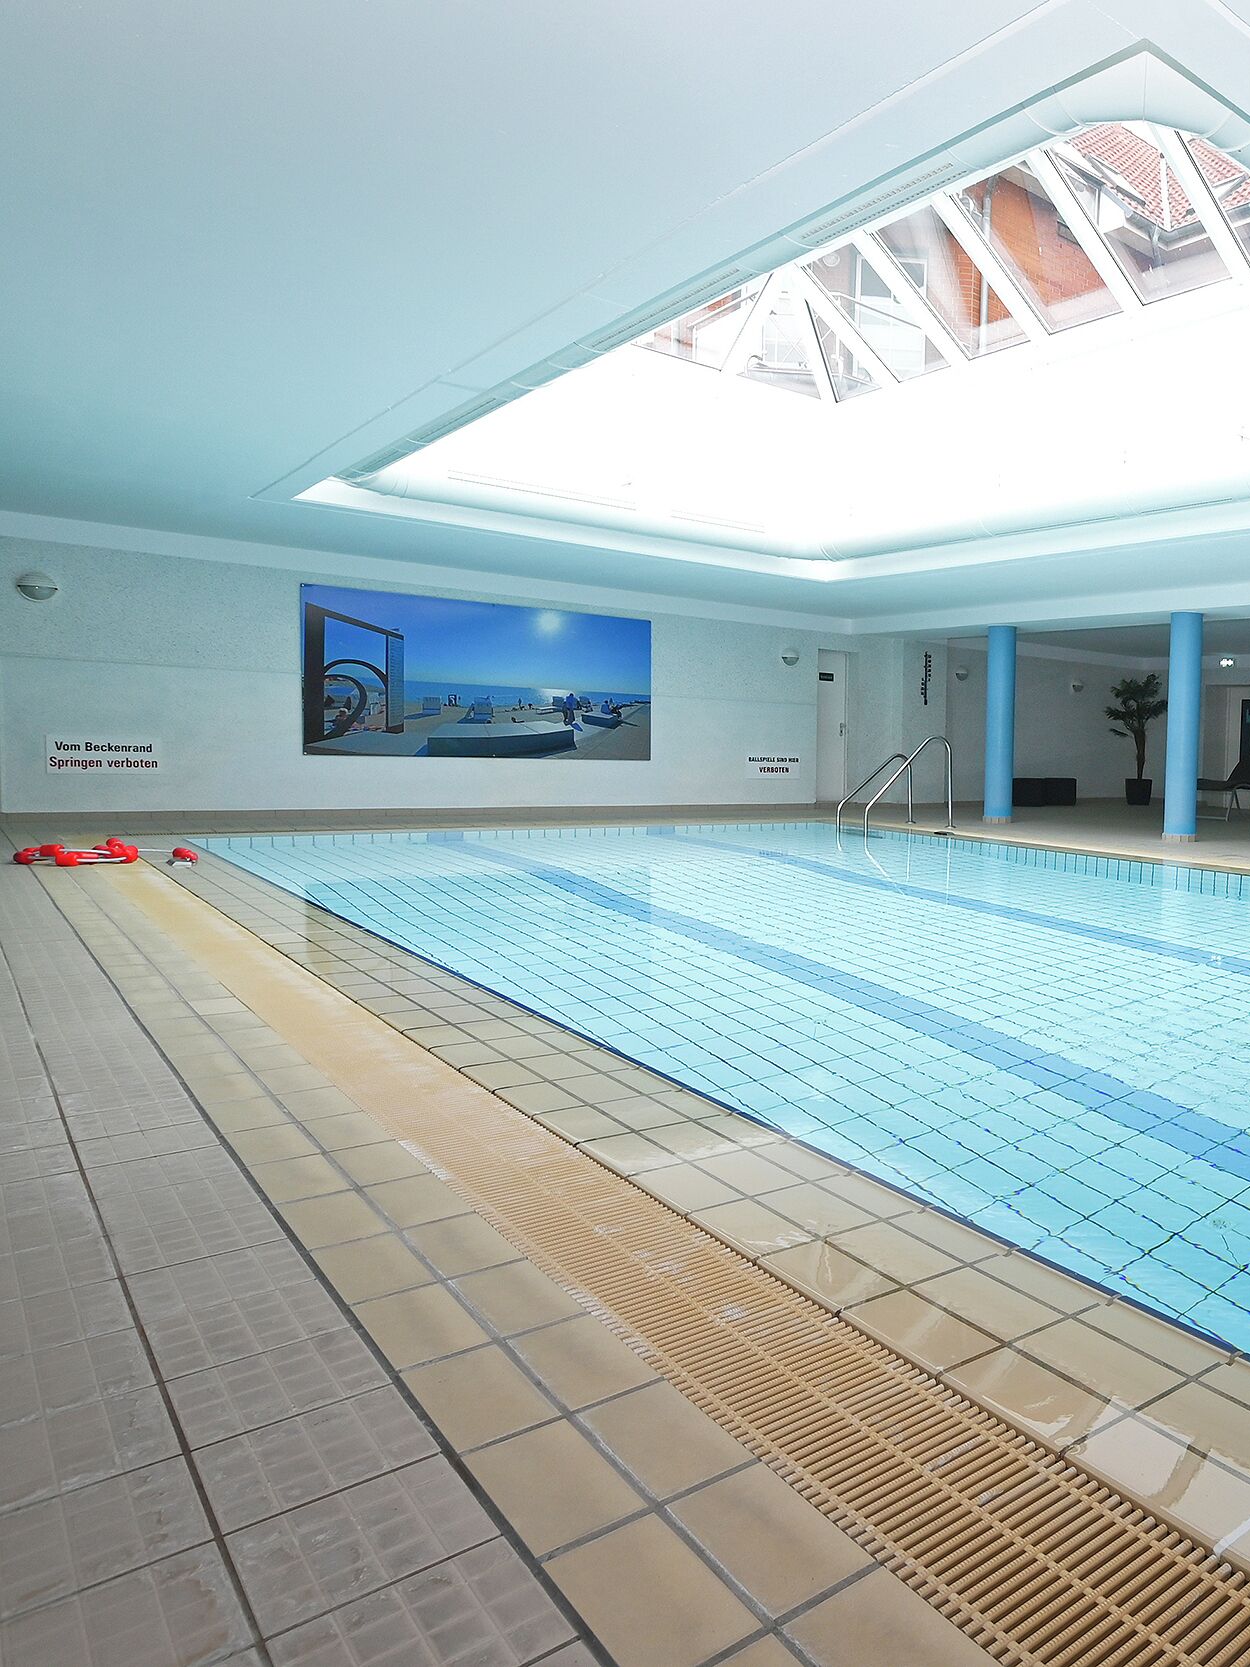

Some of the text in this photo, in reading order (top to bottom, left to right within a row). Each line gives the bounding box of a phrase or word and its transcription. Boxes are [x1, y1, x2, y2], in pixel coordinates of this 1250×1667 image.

[54, 741, 153, 753] Vom Beckenrand
[49, 756, 158, 770] Springen verboten
